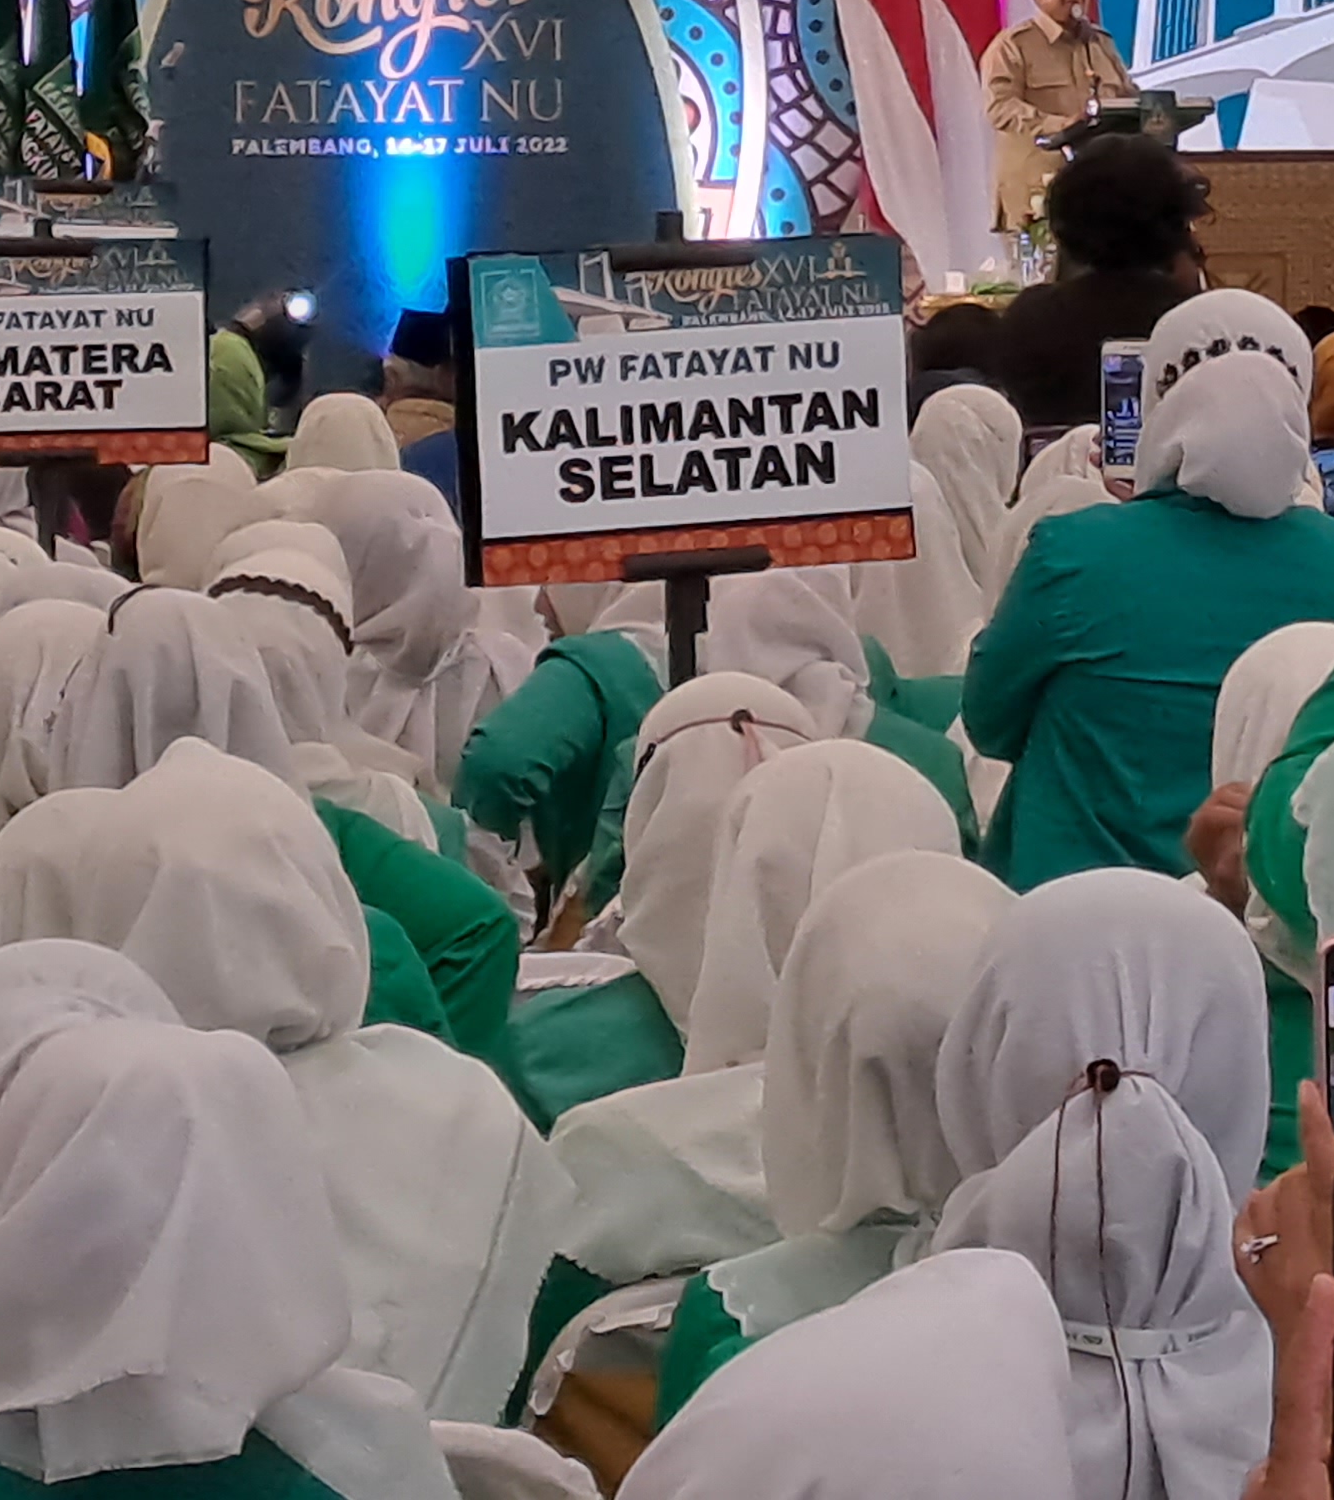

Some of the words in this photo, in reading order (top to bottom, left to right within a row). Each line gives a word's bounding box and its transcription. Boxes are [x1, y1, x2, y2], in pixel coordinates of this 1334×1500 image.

[462, 11, 564, 70] XVI
[234, 78, 465, 123] FATAYAT
[480, 78, 564, 123] NU
[232, 137, 380, 158] PALEMBANG,
[454, 137, 511, 154] JULI
[517, 137, 569, 154] 2022
[116, 308, 154, 327] NU
[549, 355, 606, 387] PW
[620, 345, 776, 381] FATAYAT
[788, 340, 841, 370] NU
[501, 388, 880, 454] KALIMANTAN
[558, 441, 837, 503] SELATAN
